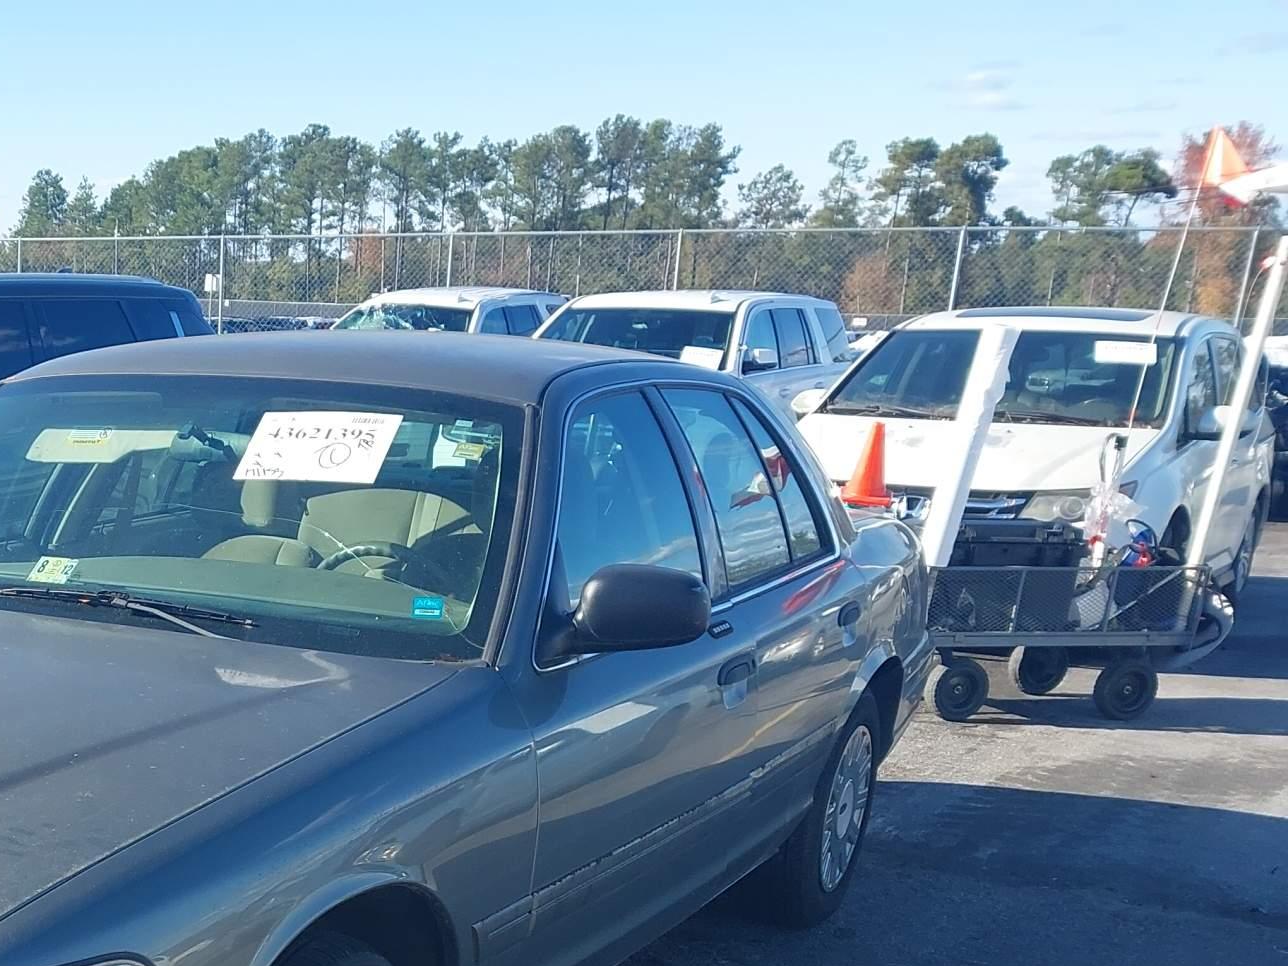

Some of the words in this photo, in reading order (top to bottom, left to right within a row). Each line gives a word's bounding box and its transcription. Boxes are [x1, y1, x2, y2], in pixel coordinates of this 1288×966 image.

[268, 427, 377, 440] 43621395
[37, 560, 49, 573] 8
[62, 564, 74, 575] 12
